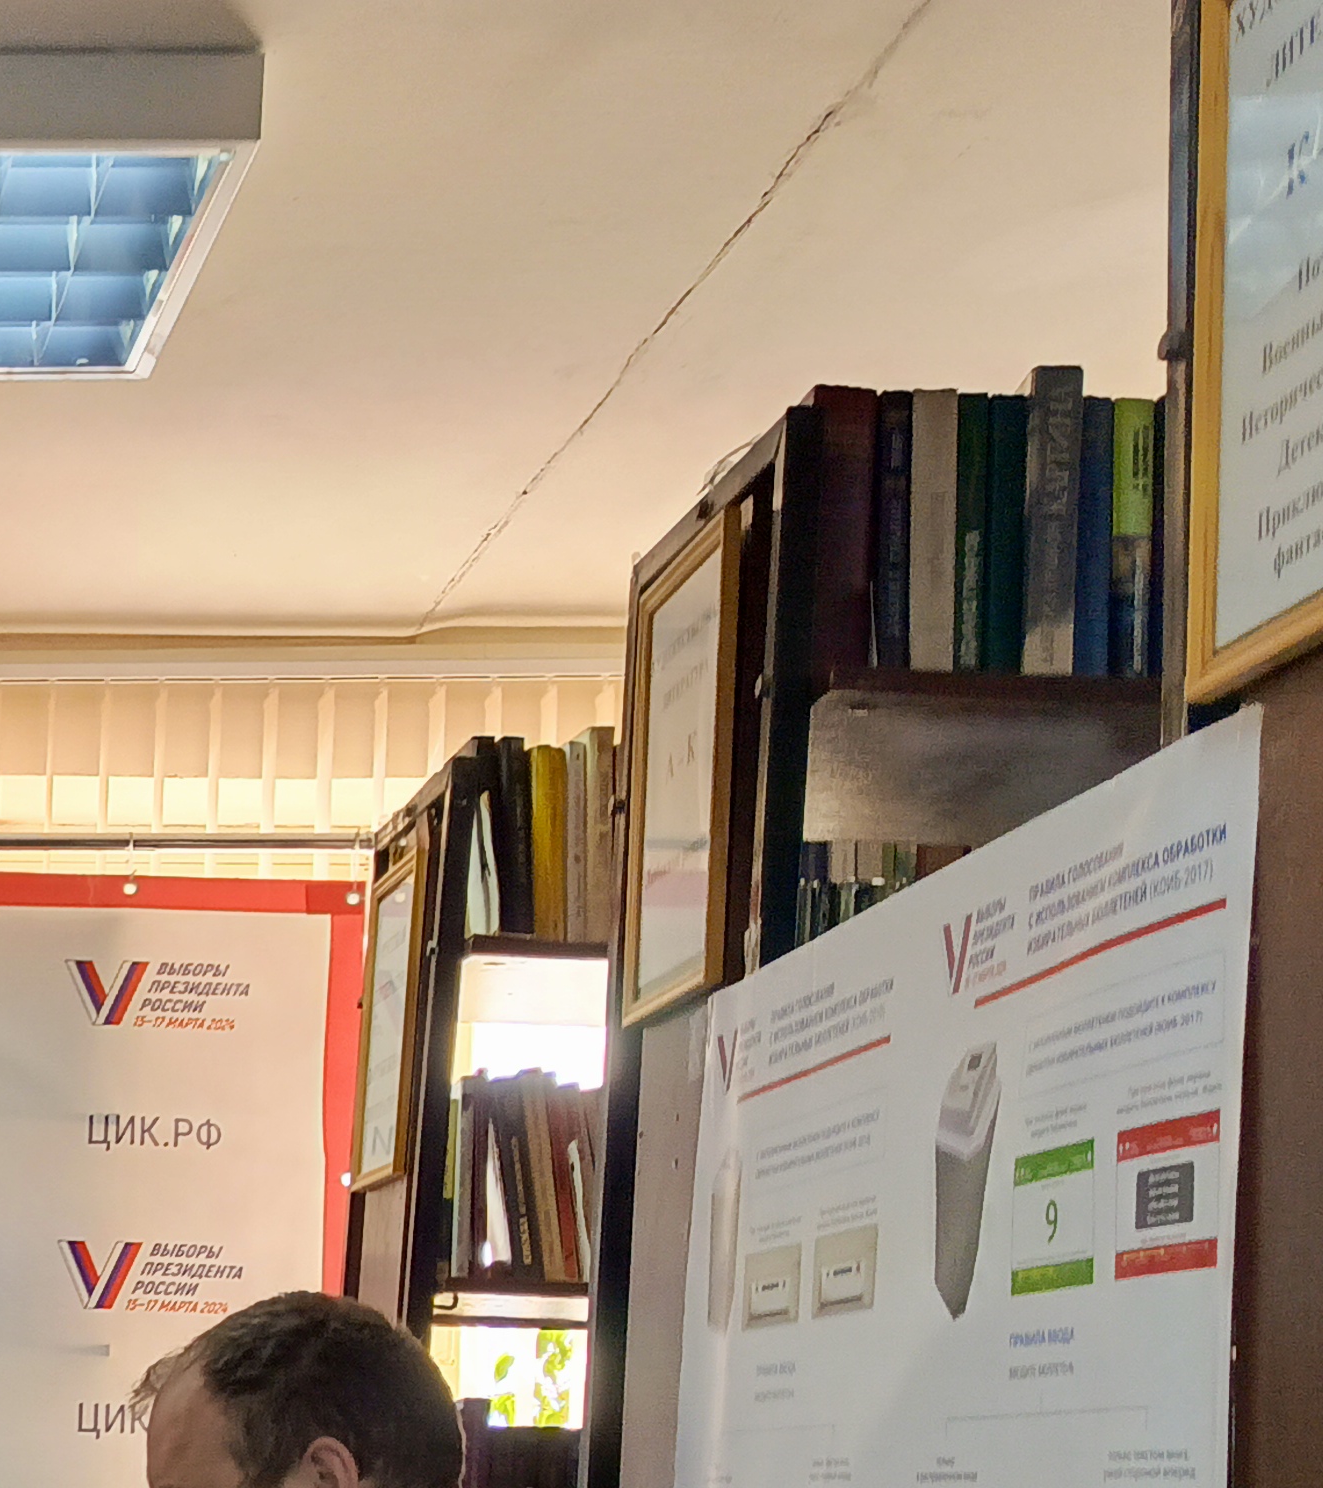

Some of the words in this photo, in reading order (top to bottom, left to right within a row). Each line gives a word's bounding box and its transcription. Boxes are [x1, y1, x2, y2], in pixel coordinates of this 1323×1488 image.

[1162, 822, 1227, 864] ОБРАБОТКИ
[156, 962, 229, 977] ВЫБОРЫ
[147, 980, 250, 997] ПРЕЗИДЕНТА
[139, 998, 206, 1013] РОССИИ
[165, 1016, 204, 1030] МАРТА
[205, 1018, 235, 1031] 2024
[87, 1114, 222, 1151] ЦИК.РФ
[1045, 1199, 1058, 1245] 9
[149, 1243, 223, 1259] ВЫБОРЫ
[140, 1262, 243, 1280] ПРЕЗИДЕНТА
[131, 1280, 198, 1297] РОССИИ
[158, 1300, 198, 1314] МАРТА
[198, 1302, 228, 1315] 2024
[77, 1402, 149, 1440] ЦИК
